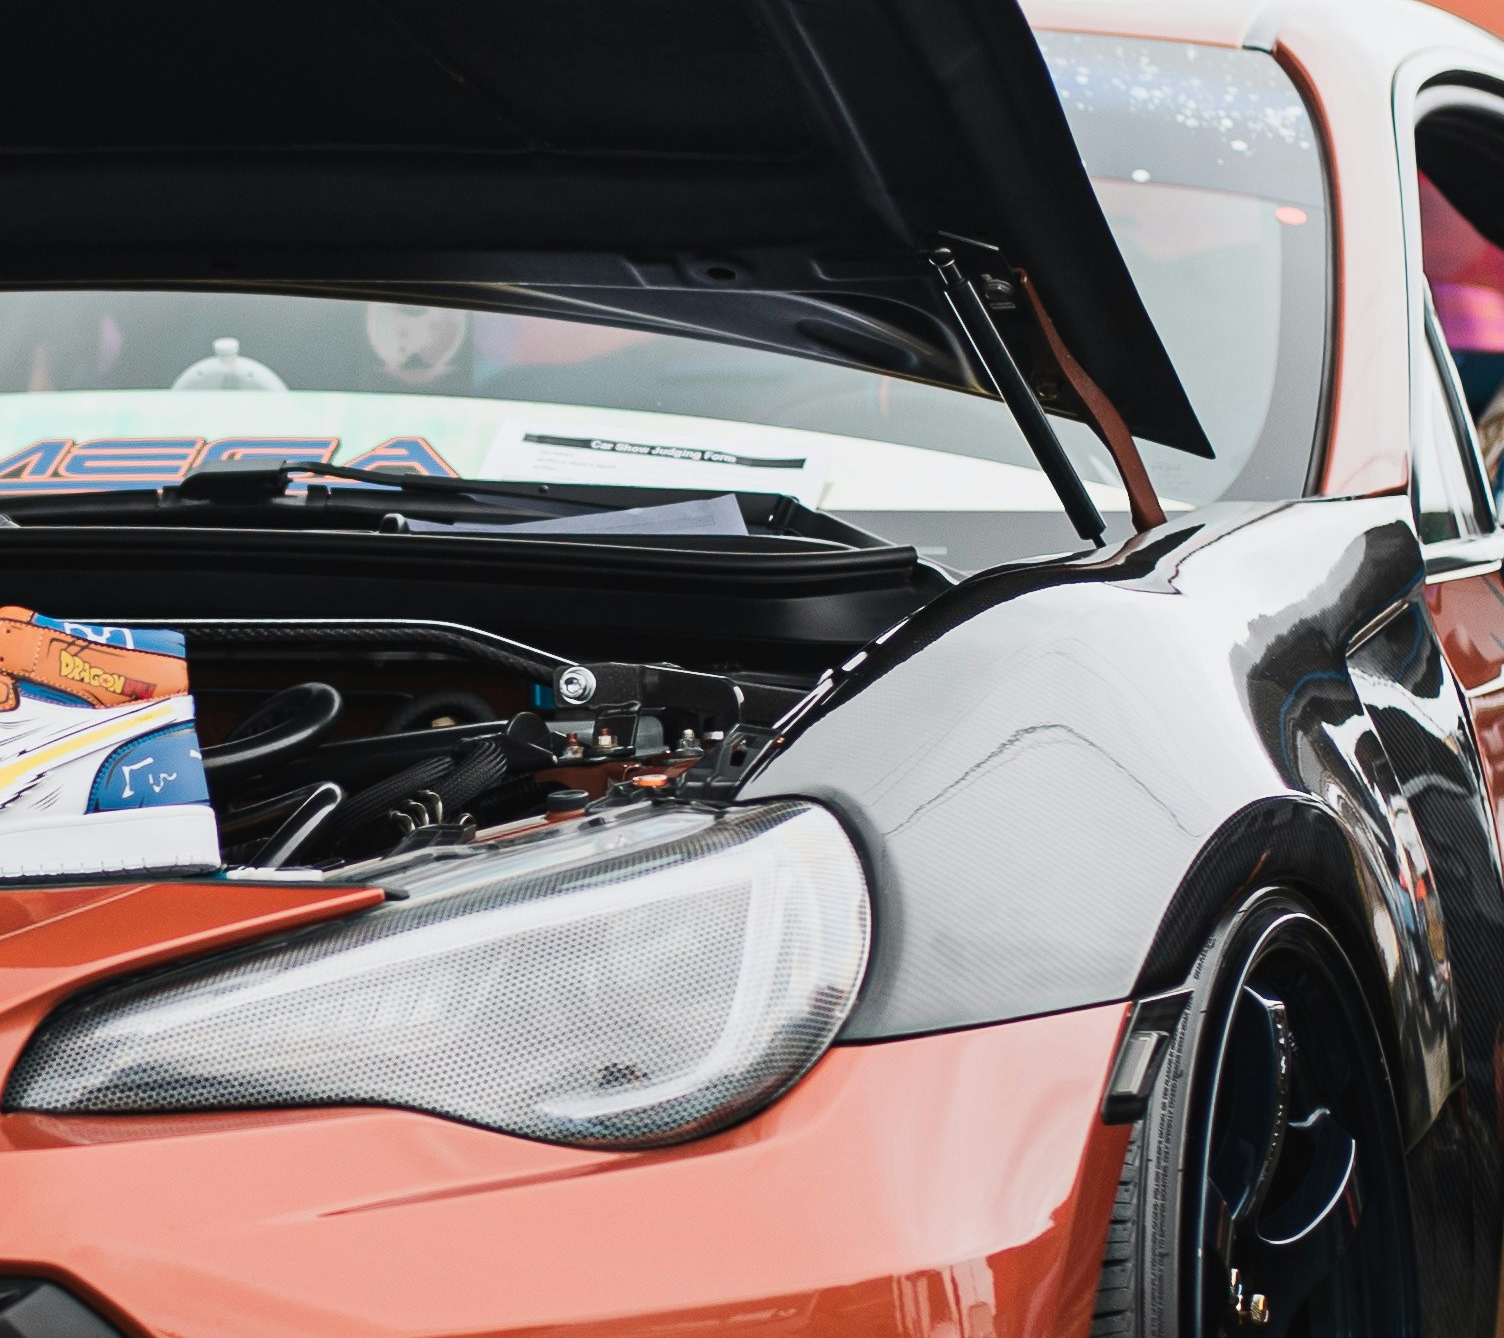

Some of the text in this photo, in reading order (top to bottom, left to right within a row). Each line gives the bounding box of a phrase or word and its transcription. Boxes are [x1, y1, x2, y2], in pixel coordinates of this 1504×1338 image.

[591, 440, 737, 463] Car Show Judging Form
[60, 649, 127, 695] DRAGON
